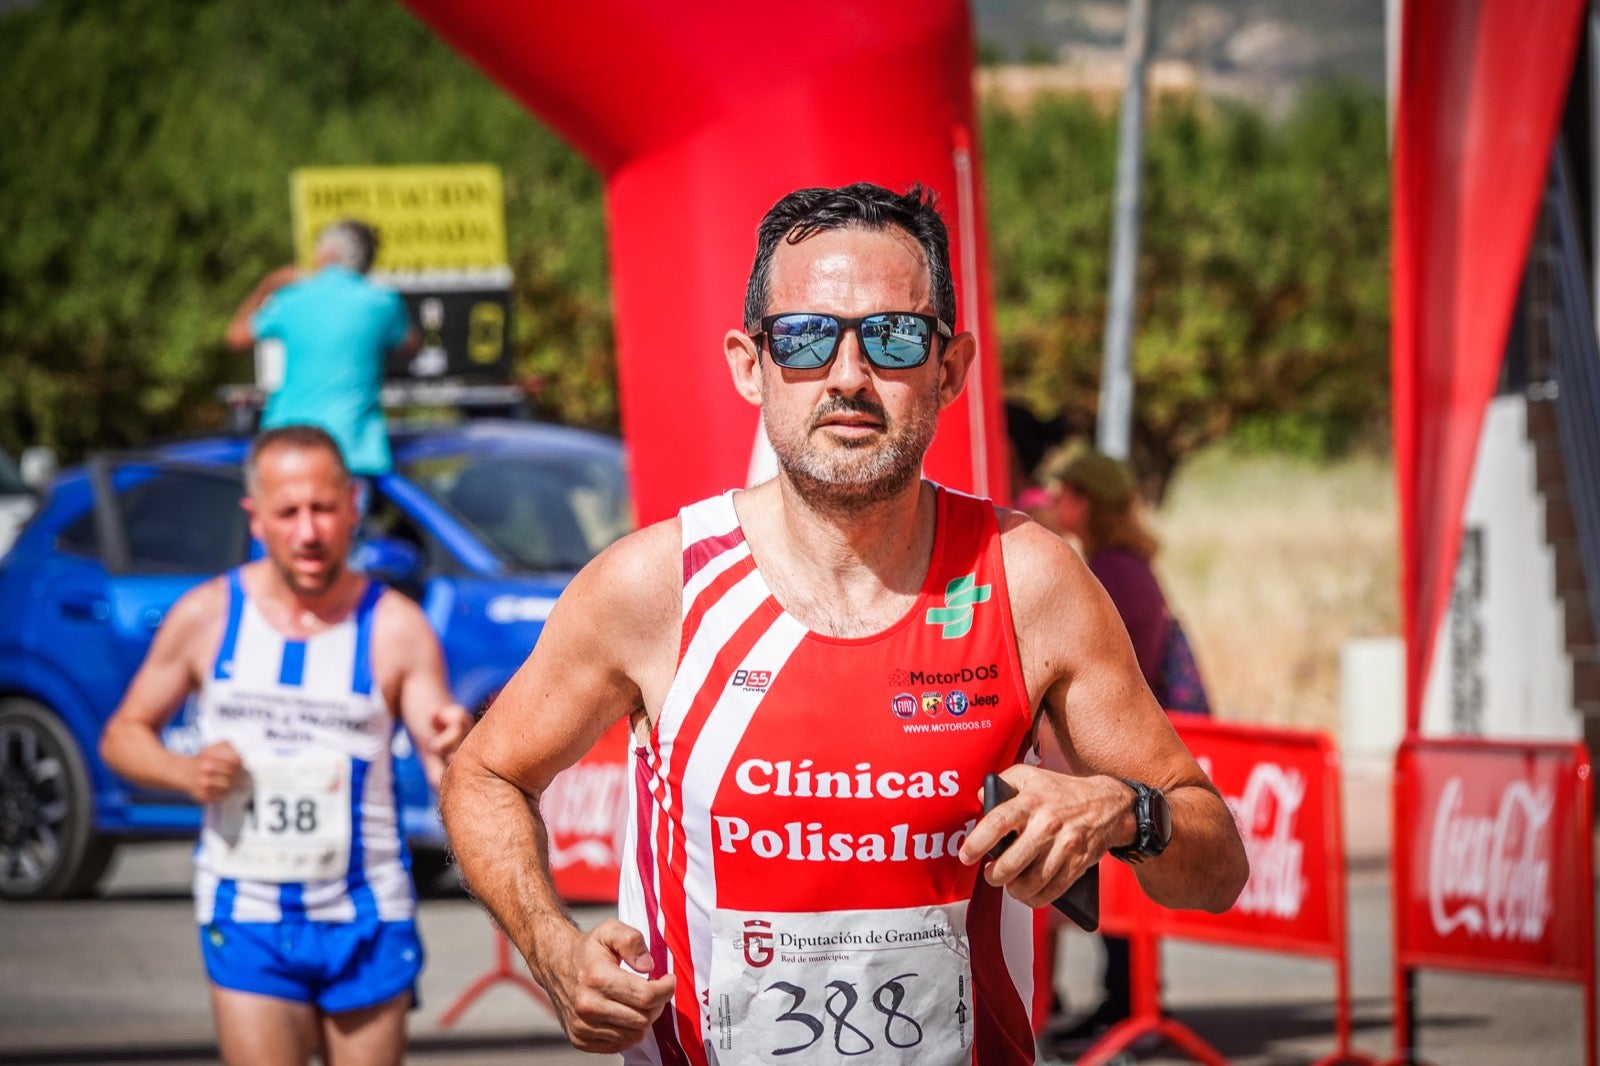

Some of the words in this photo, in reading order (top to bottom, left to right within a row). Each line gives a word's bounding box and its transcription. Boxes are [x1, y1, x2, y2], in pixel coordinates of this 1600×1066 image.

[910, 664, 998, 685] MotorDOS
[897, 699, 912, 713] FIAT
[970, 694, 999, 708] Jeep
[903, 720, 992, 733] WWW.MOTORDOS.ES
[735, 759, 959, 798] Clínicas
[713, 815, 977, 862] Polisalud
[780, 932, 862, 950] Diputación
[866, 930, 882, 944] de
[885, 924, 945, 943] Granada
[781, 954, 795, 963] Red
[798, 954, 806, 963] de
[808, 953, 849, 963] municipios
[764, 973, 923, 1056] 388
